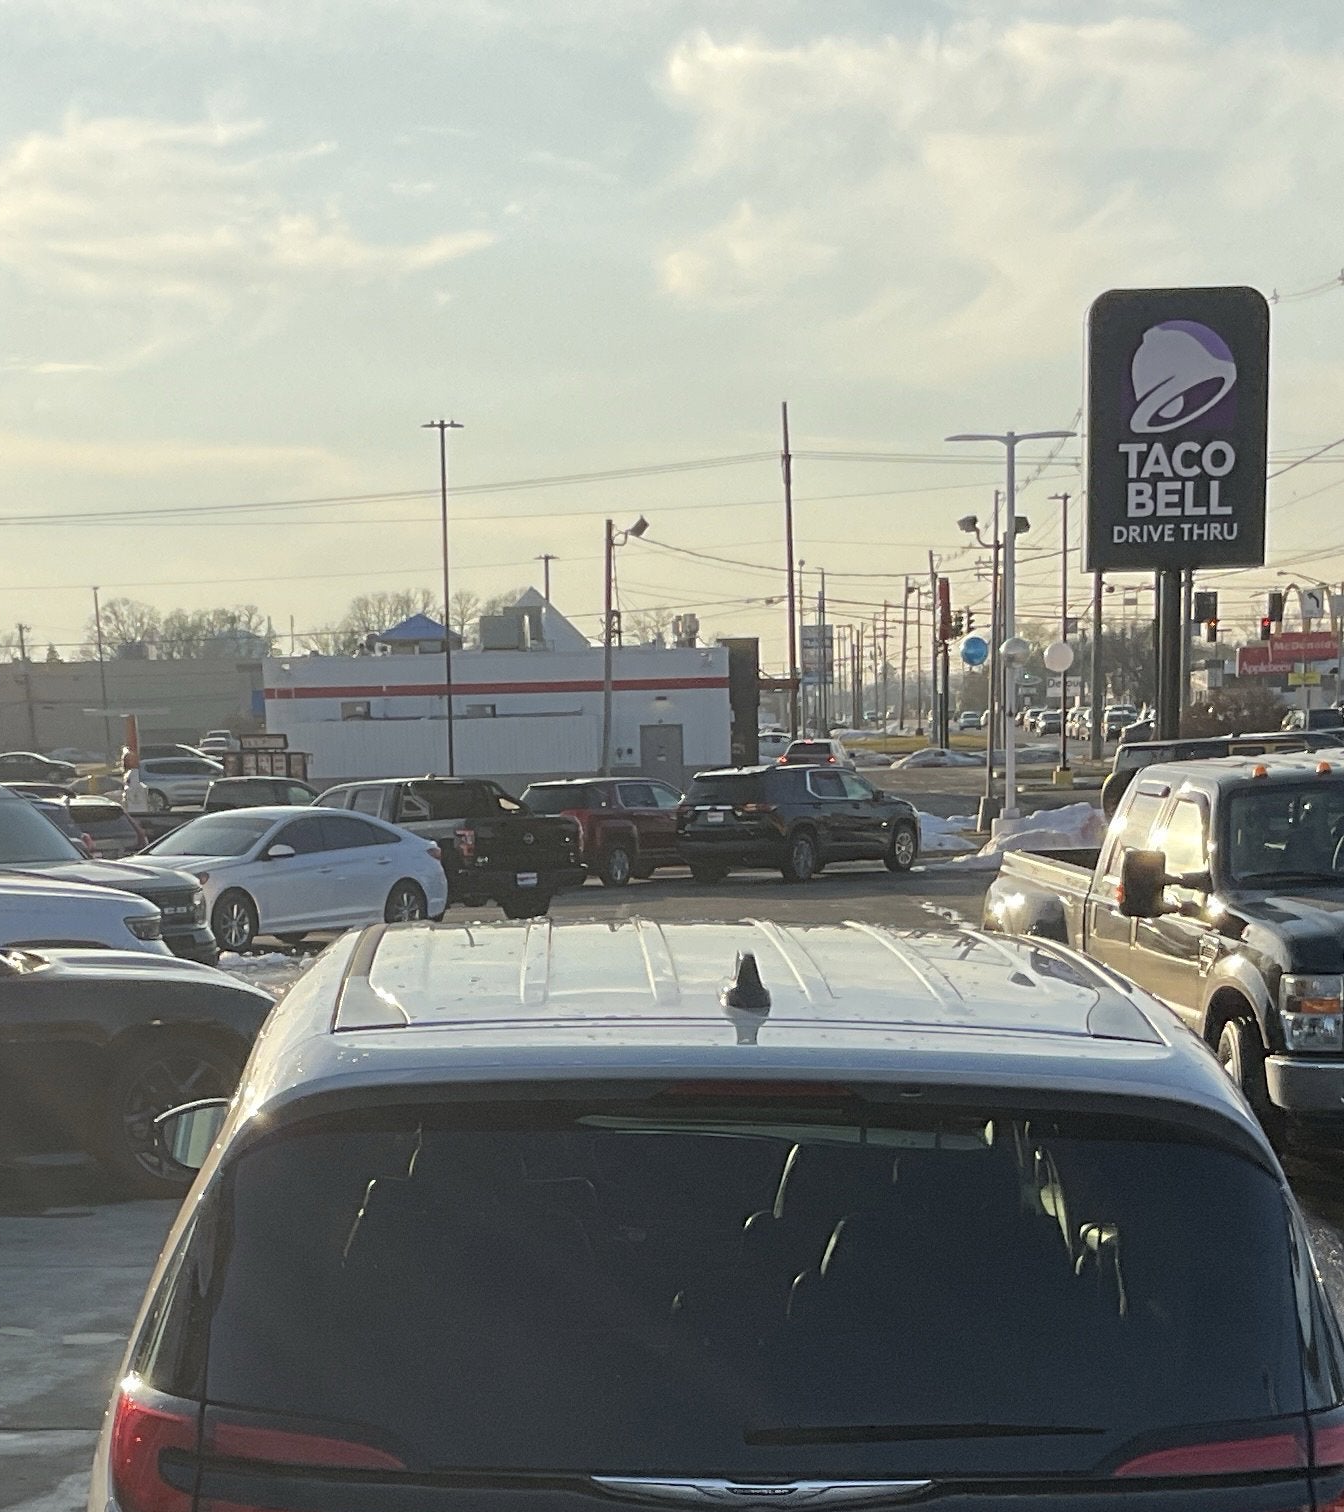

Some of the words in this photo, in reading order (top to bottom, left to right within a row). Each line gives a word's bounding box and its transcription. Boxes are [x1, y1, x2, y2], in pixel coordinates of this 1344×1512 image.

[1118, 440, 1236, 479] TACO
[1126, 480, 1233, 518] BELL
[1112, 524, 1175, 544] DRIVE
[1180, 522, 1238, 542] THRU
